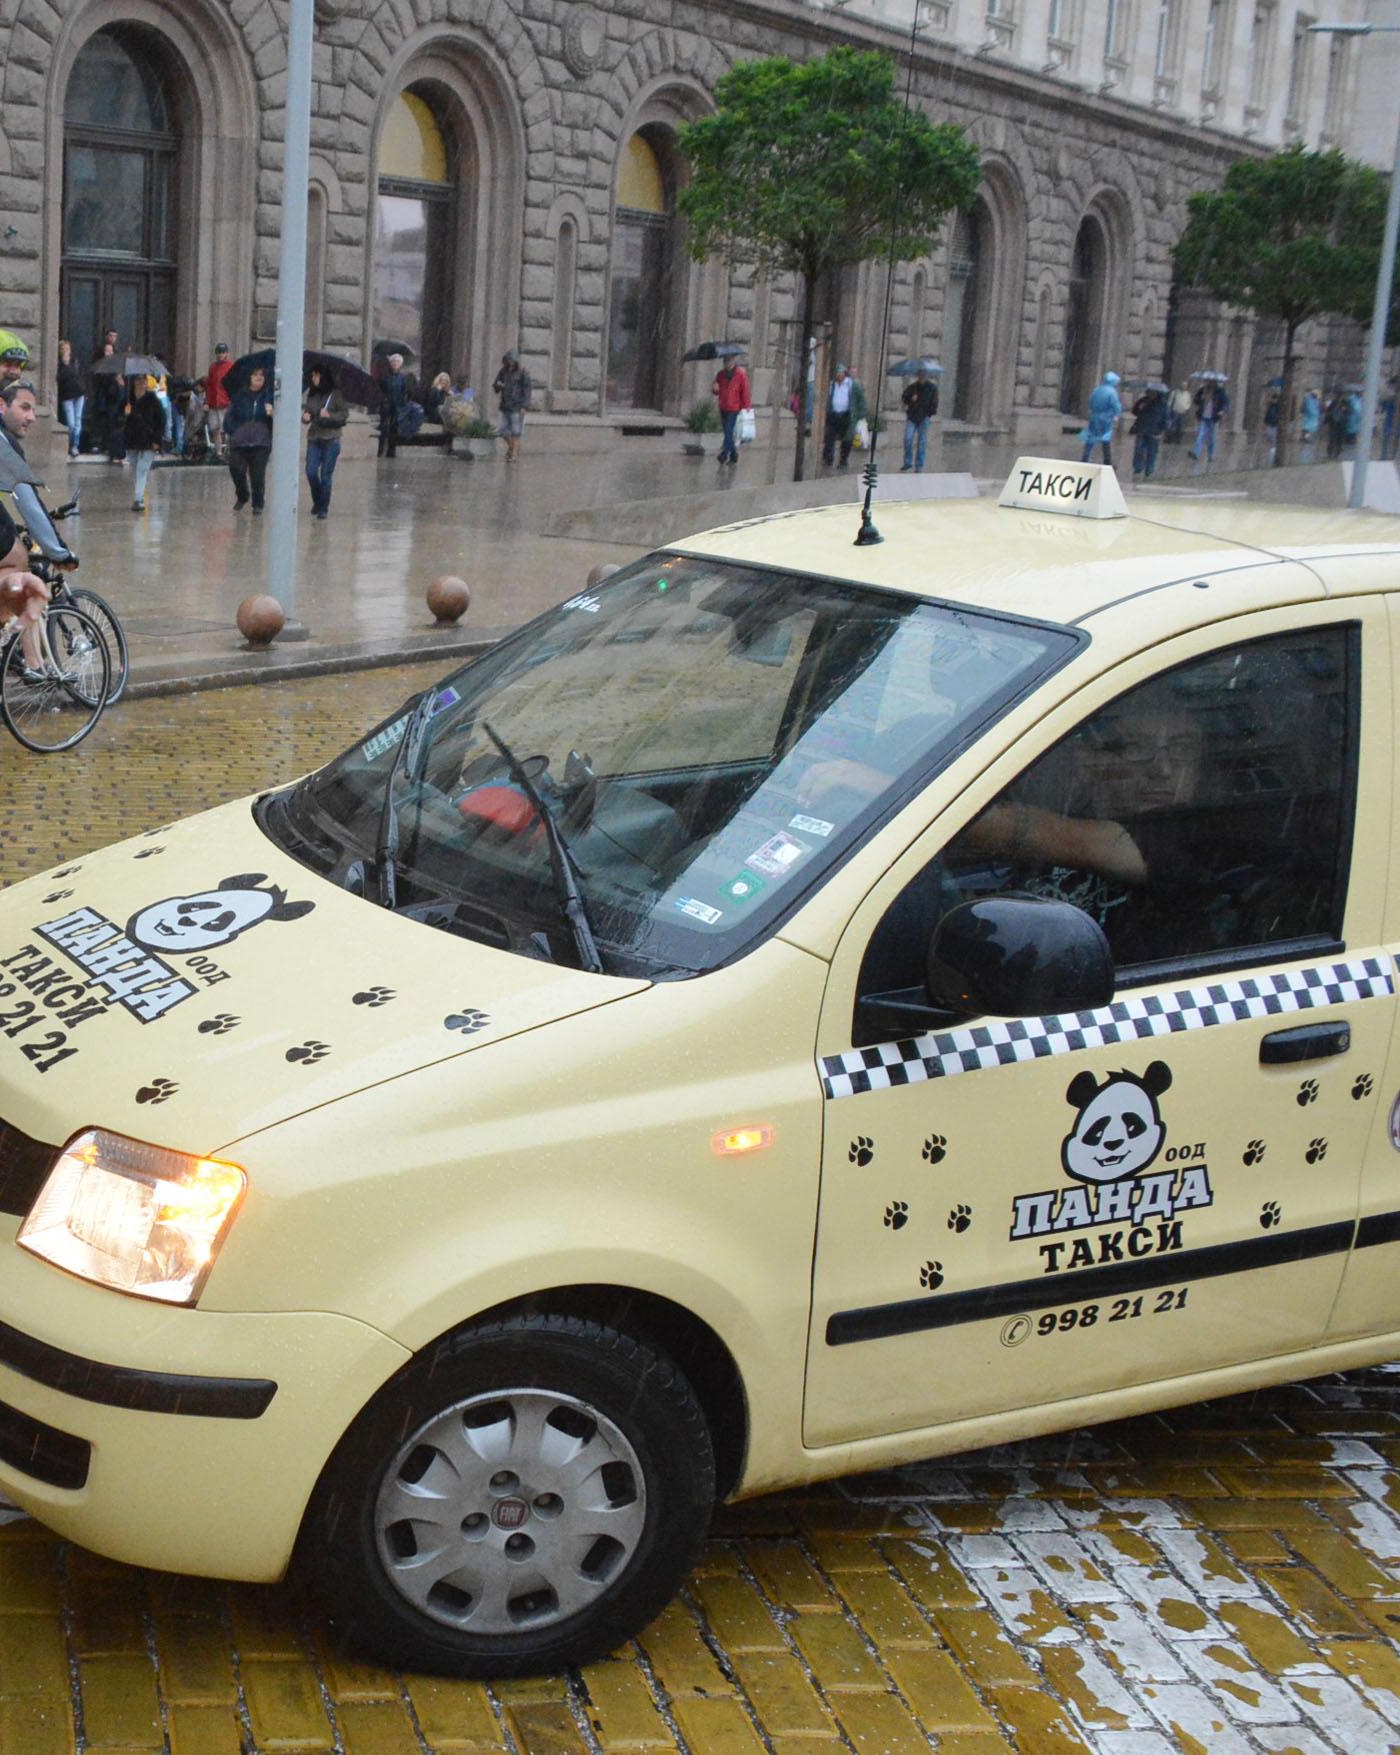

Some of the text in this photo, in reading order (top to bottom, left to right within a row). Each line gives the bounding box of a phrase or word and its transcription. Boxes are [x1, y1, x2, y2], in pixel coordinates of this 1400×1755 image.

[1020, 470, 1093, 501] ТАКСИ
[0, 943, 108, 1029] ТАКСИ
[33, 907, 199, 1023] ПАНДА
[20, 1031, 79, 1074] 21
[1009, 1164, 1214, 1242] ПАНДА
[1039, 1221, 1183, 1273] ТАКСИ
[1037, 1288, 1188, 1336] 998 21 21
